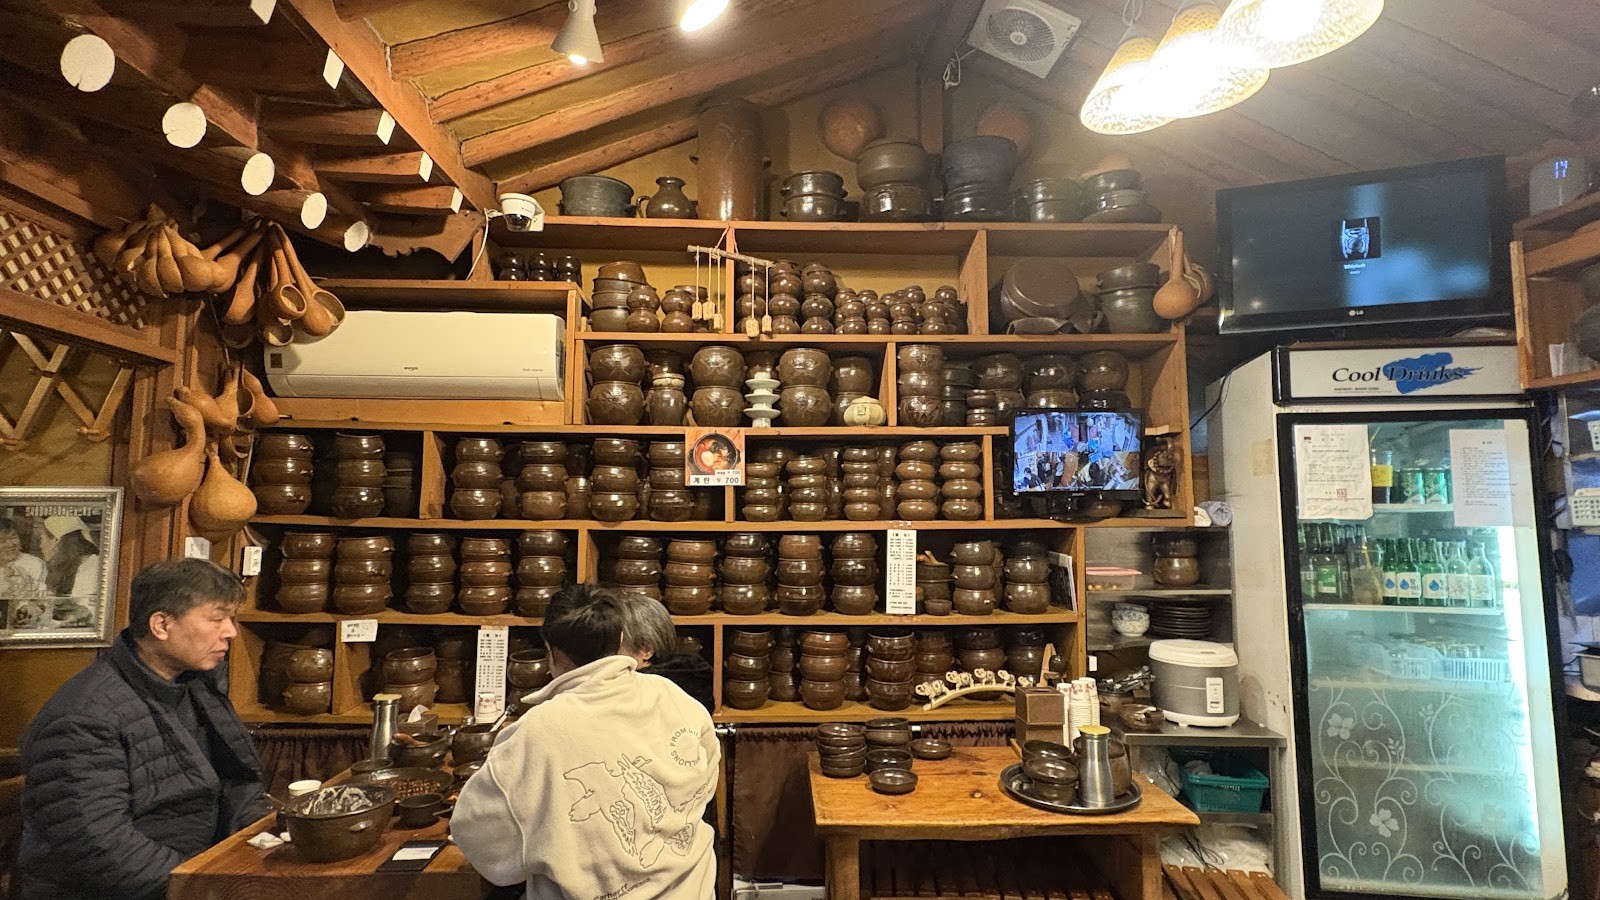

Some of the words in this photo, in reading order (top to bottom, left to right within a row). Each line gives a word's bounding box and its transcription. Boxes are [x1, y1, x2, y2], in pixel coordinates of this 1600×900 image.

[1332, 366, 1381, 382] Cool
[1387, 365, 1464, 382] Drinks
[725, 476, 739, 484] 700
[669, 727, 687, 747] FROM
